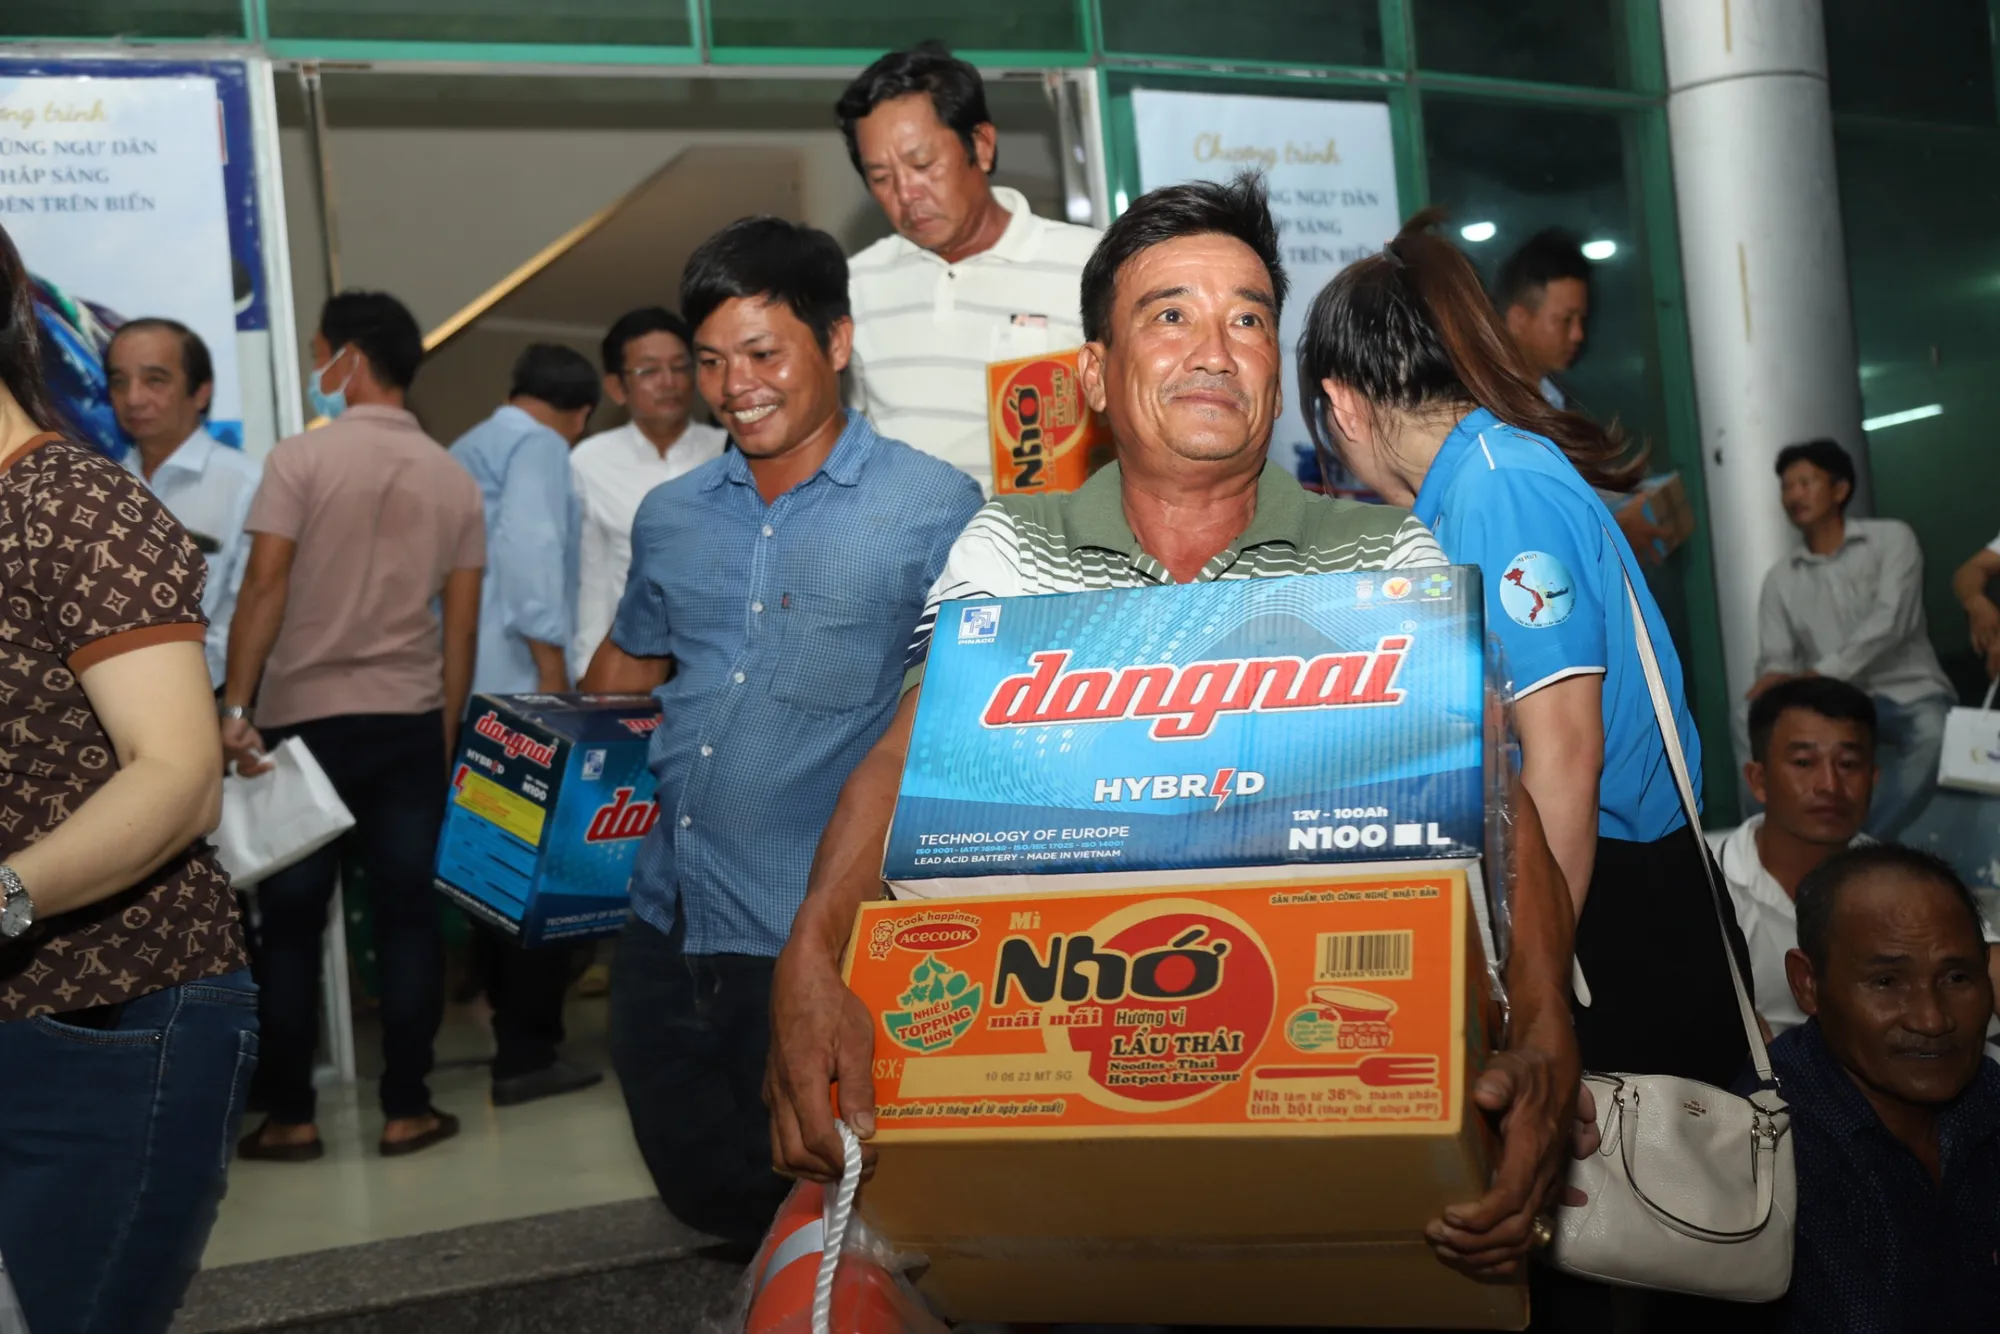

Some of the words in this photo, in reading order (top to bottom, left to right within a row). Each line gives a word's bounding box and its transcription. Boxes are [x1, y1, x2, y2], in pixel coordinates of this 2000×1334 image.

[979, 634, 1415, 742] dongnai
[1292, 810, 1321, 821] 12V
[1333, 806, 1388, 819] 100Ah
[919, 830, 1030, 846] TECHNOLOGY
[1033, 829, 1057, 841] OF
[1061, 826, 1130, 840] EUROPE
[1288, 824, 1387, 851] N100
[1427, 822, 1451, 845] L
[914, 857, 942, 866] LEAD
[943, 855, 969, 864] ACID
[971, 853, 1017, 863] BATTERY
[1027, 851, 1059, 861] MADE
[1060, 851, 1072, 859] IN
[1073, 849, 1121, 859] VIETNAM
[896, 911, 924, 928] Cook
[927, 909, 980, 926] happiness
[994, 929, 1227, 1005] Nhớ
[898, 1007, 971, 1041] TOPPING
[1116, 1010, 1165, 1026] Hương
[1113, 1027, 1169, 1055] LẨU
[1175, 1030, 1242, 1053] THÁI
[872, 1058, 900, 1079] SX:
[1110, 1062, 1165, 1071] Noodles
[1177, 1058, 1215, 1069] Thai
[1108, 1074, 1167, 1085] Hotpot
[1172, 1072, 1240, 1083] Flavour
